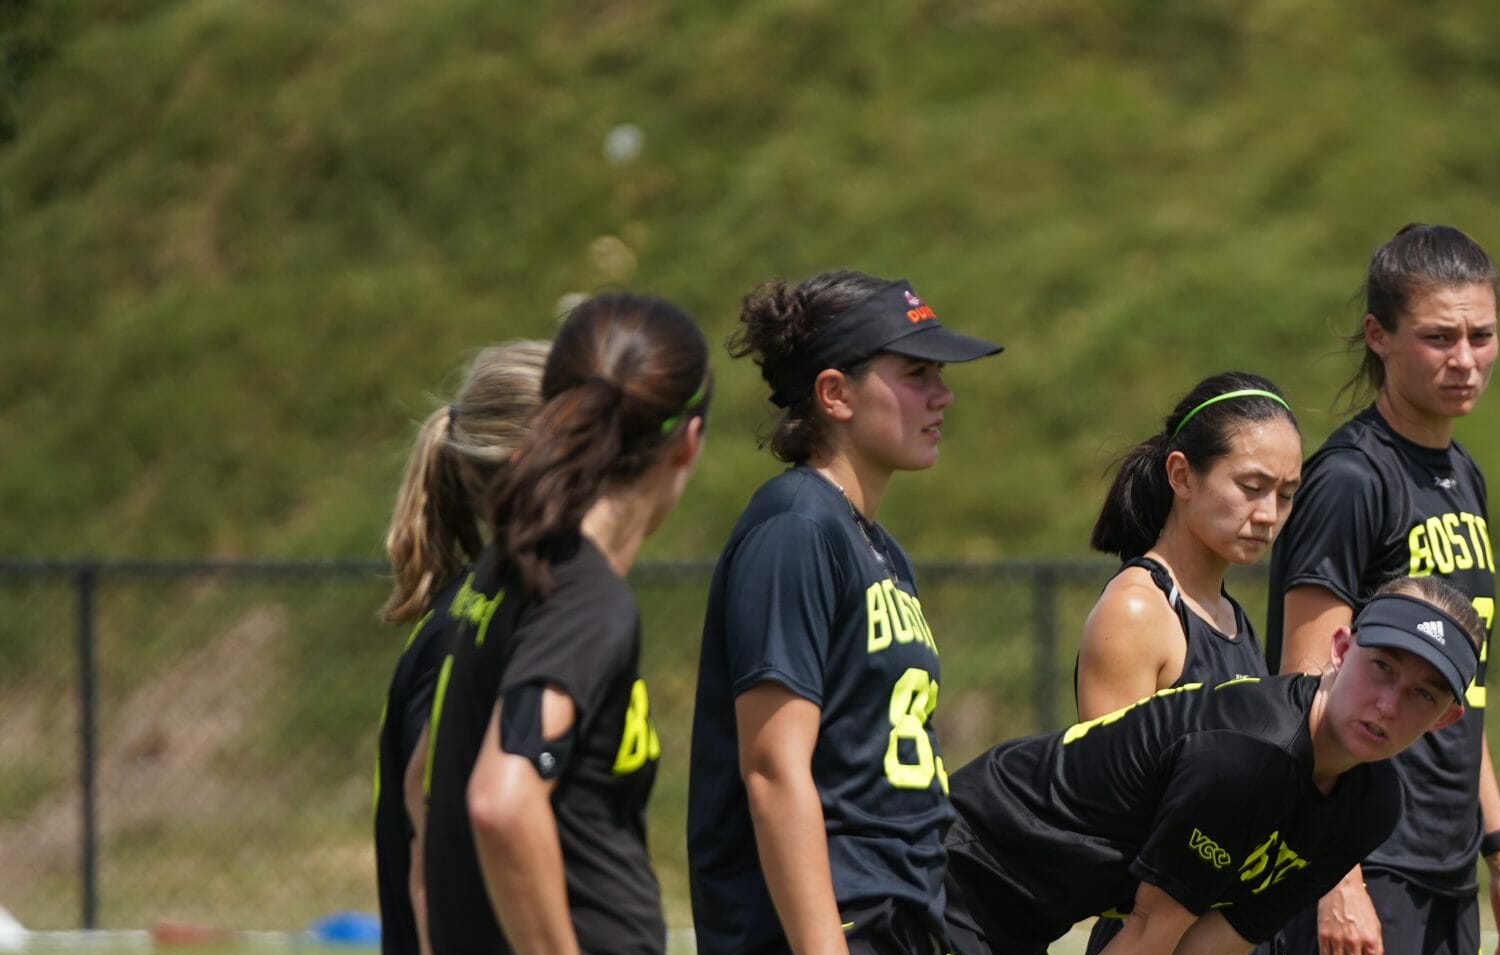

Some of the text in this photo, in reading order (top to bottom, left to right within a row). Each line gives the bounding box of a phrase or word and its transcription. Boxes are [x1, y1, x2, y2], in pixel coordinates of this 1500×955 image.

[866, 578, 939, 655] BOST
[1417, 623, 1446, 645] adidas
[884, 668, 949, 796] 8
